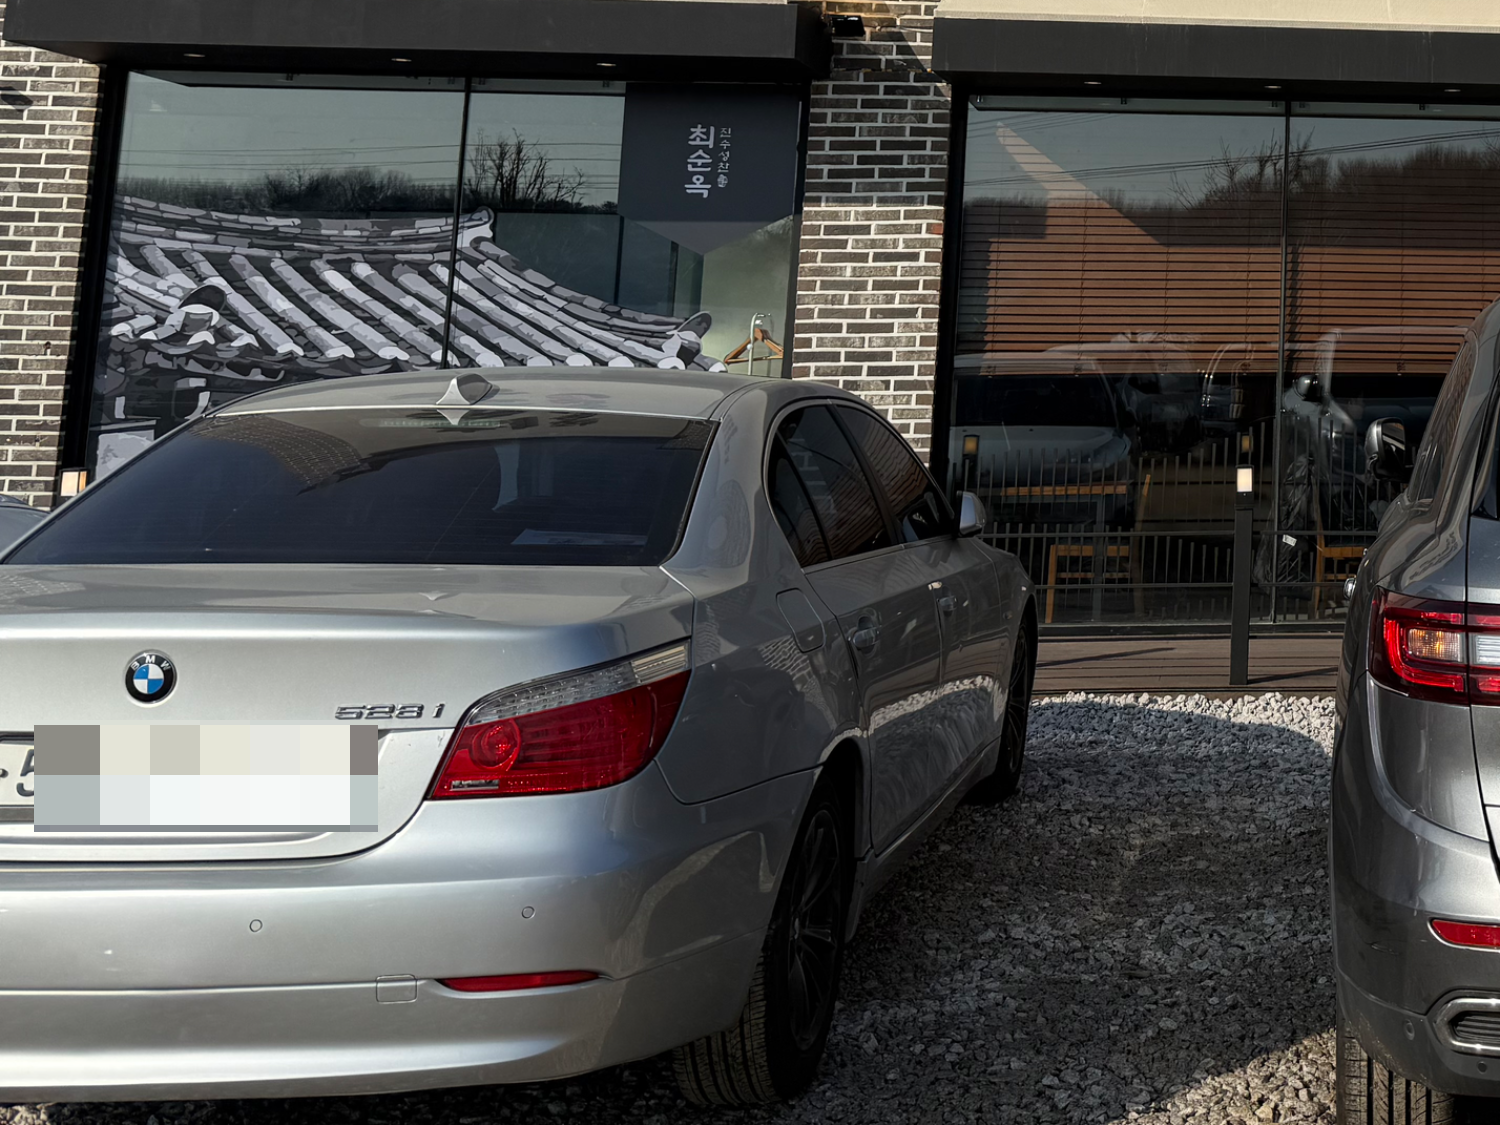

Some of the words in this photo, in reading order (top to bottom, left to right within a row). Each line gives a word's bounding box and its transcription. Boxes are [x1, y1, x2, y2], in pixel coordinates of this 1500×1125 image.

[684, 124, 715, 199] 최순옥
[717, 127, 731, 173] 진수성찬
[130, 653, 172, 671] BMW
